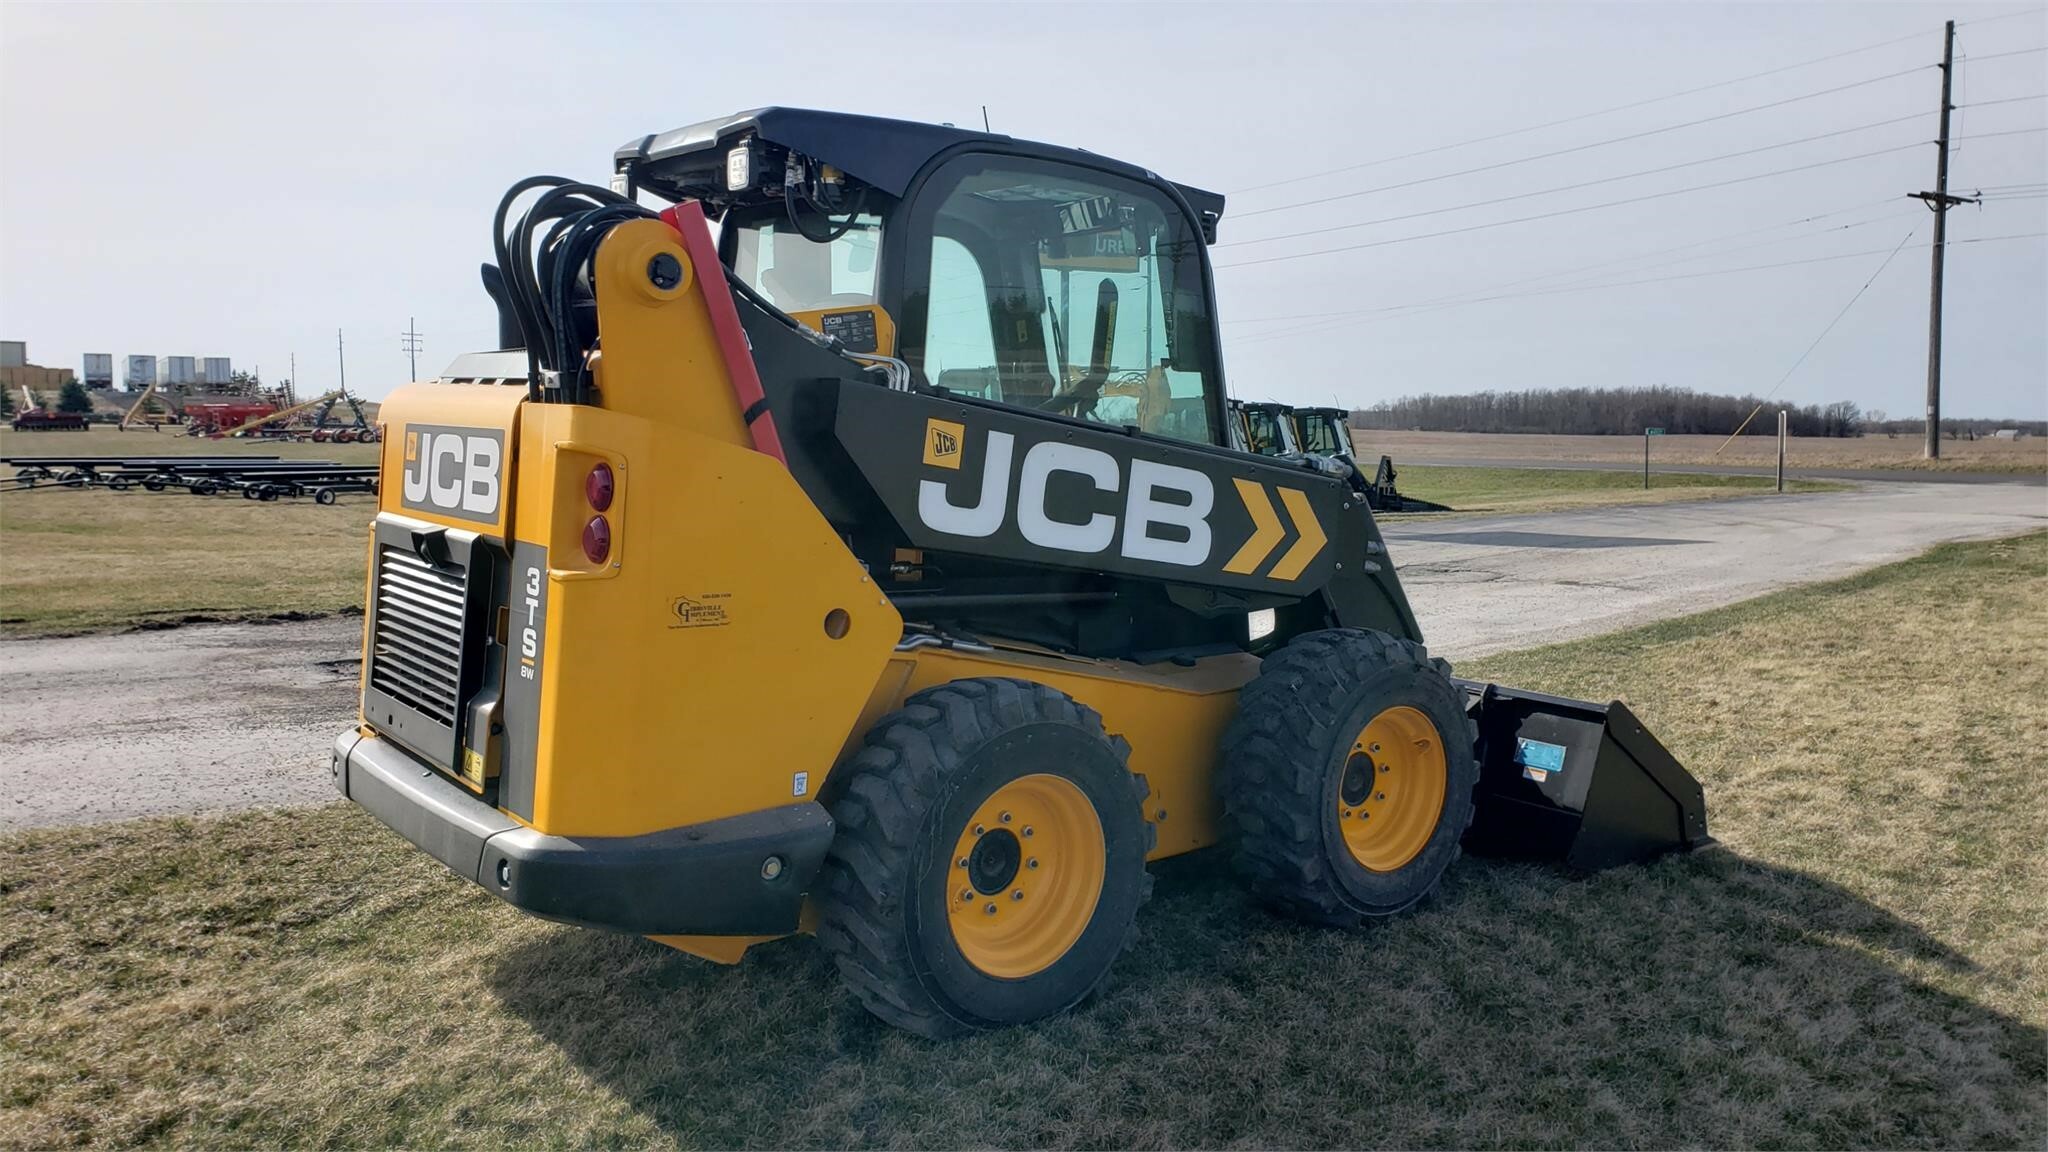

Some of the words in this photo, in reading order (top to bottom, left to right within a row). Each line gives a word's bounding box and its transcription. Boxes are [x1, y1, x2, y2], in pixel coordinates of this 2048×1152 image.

[404, 433, 500, 514] JCB
[936, 432, 956, 454] JCB
[918, 430, 1215, 566] JCB
[522, 567, 540, 658] 3TS
